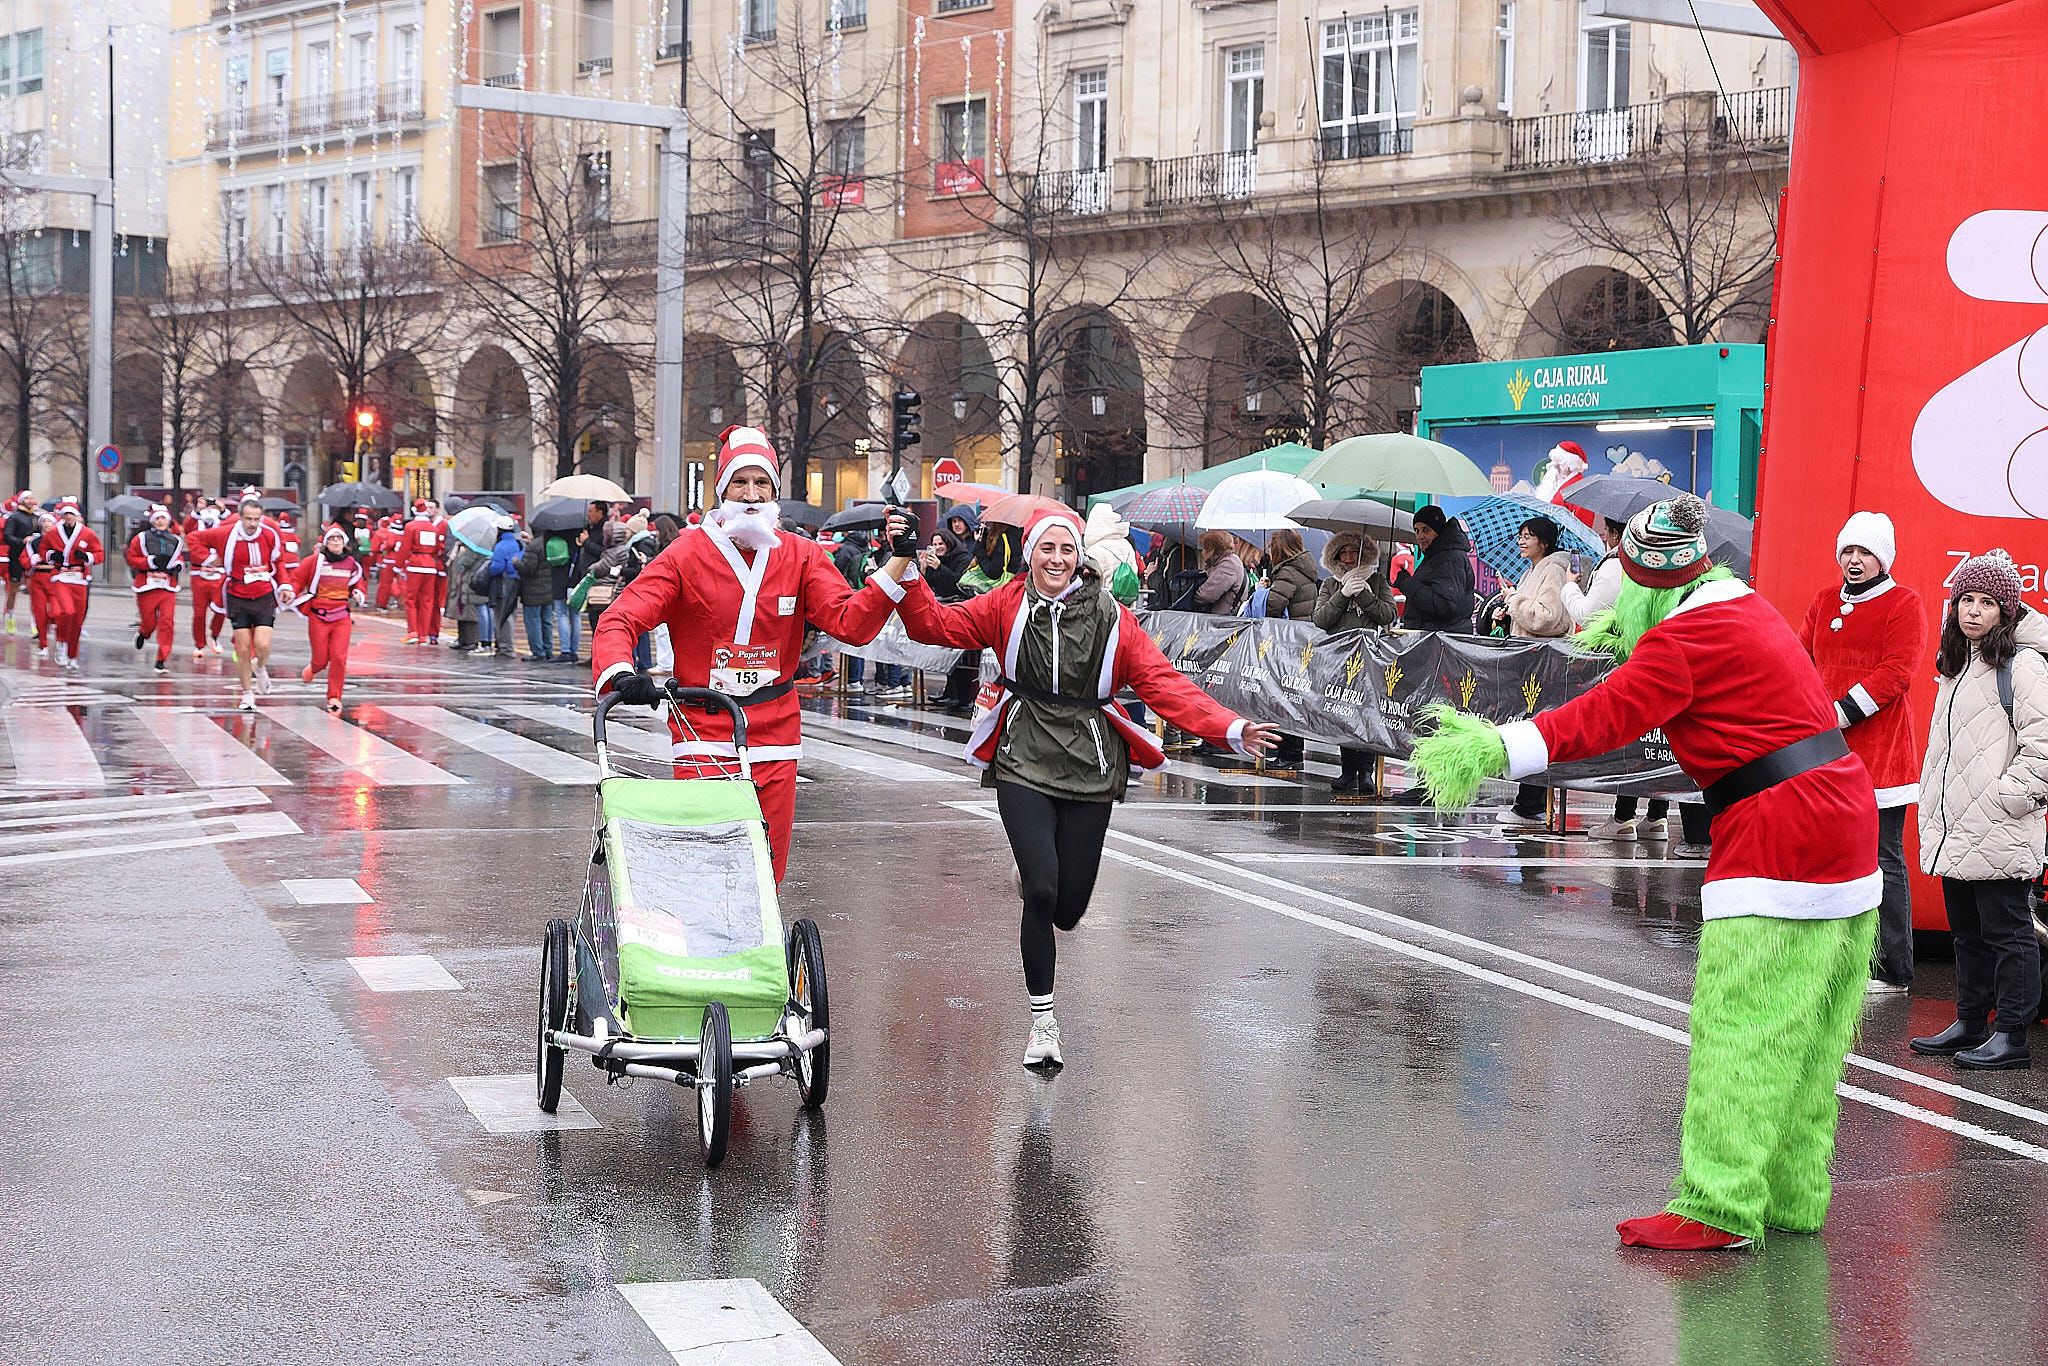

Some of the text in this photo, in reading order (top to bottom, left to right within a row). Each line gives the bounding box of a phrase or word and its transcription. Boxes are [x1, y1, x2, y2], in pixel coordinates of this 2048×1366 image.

[1533, 363, 1608, 389] CAJA RURAL
[1541, 388, 1599, 409] DE ARAGÓN
[936, 472, 961, 483] STOP
[735, 671, 759, 684] 153
[1281, 674, 1294, 688] CAJA
[1325, 684, 1365, 706] CAJA RURAL
[1323, 701, 1356, 718] DE ARAGÓN
[1644, 748, 1656, 760] DE
